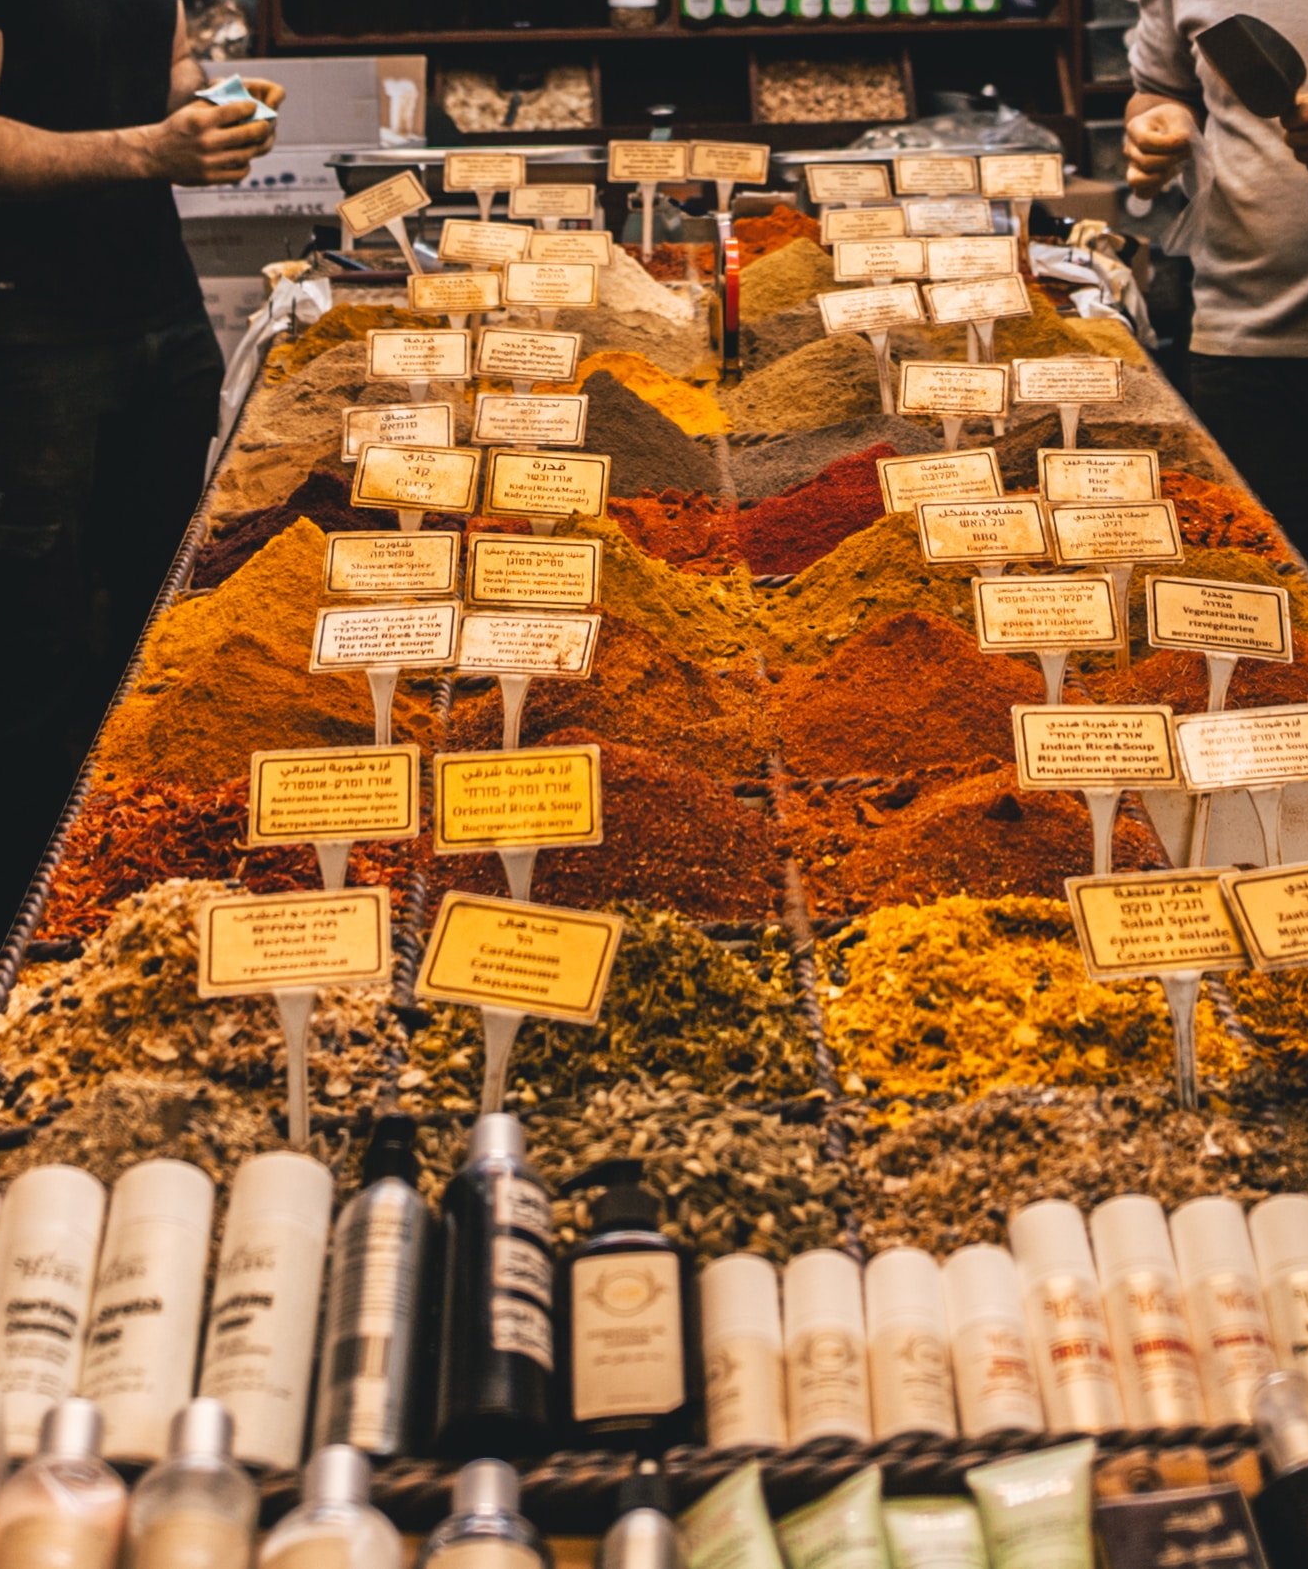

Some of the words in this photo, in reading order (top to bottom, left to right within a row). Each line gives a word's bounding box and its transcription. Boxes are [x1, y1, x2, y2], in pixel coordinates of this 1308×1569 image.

[491, 349, 526, 357] English
[530, 351, 564, 361] Pepper
[395, 477, 436, 491] Curry
[972, 533, 997, 543] BBQ
[1050, 607, 1077, 616] Spice
[1183, 607, 1236, 621] Vegetarian
[1238, 614, 1259, 622] Rice
[333, 634, 379, 642] Thailand
[415, 630, 441, 639] Soup
[399, 640, 434, 648] soupe
[1040, 742, 1081, 752] Indian
[1061, 754, 1101, 762] indien
[1121, 755, 1160, 764] soupe
[271, 794, 319, 804] Australian
[452, 803, 506, 818] Oriental
[551, 800, 582, 814] Soup
[1120, 915, 1163, 929] Salad
[1168, 913, 1211, 927] Spice
[1110, 931, 1162, 947] épices
[1178, 928, 1230, 940] salade
